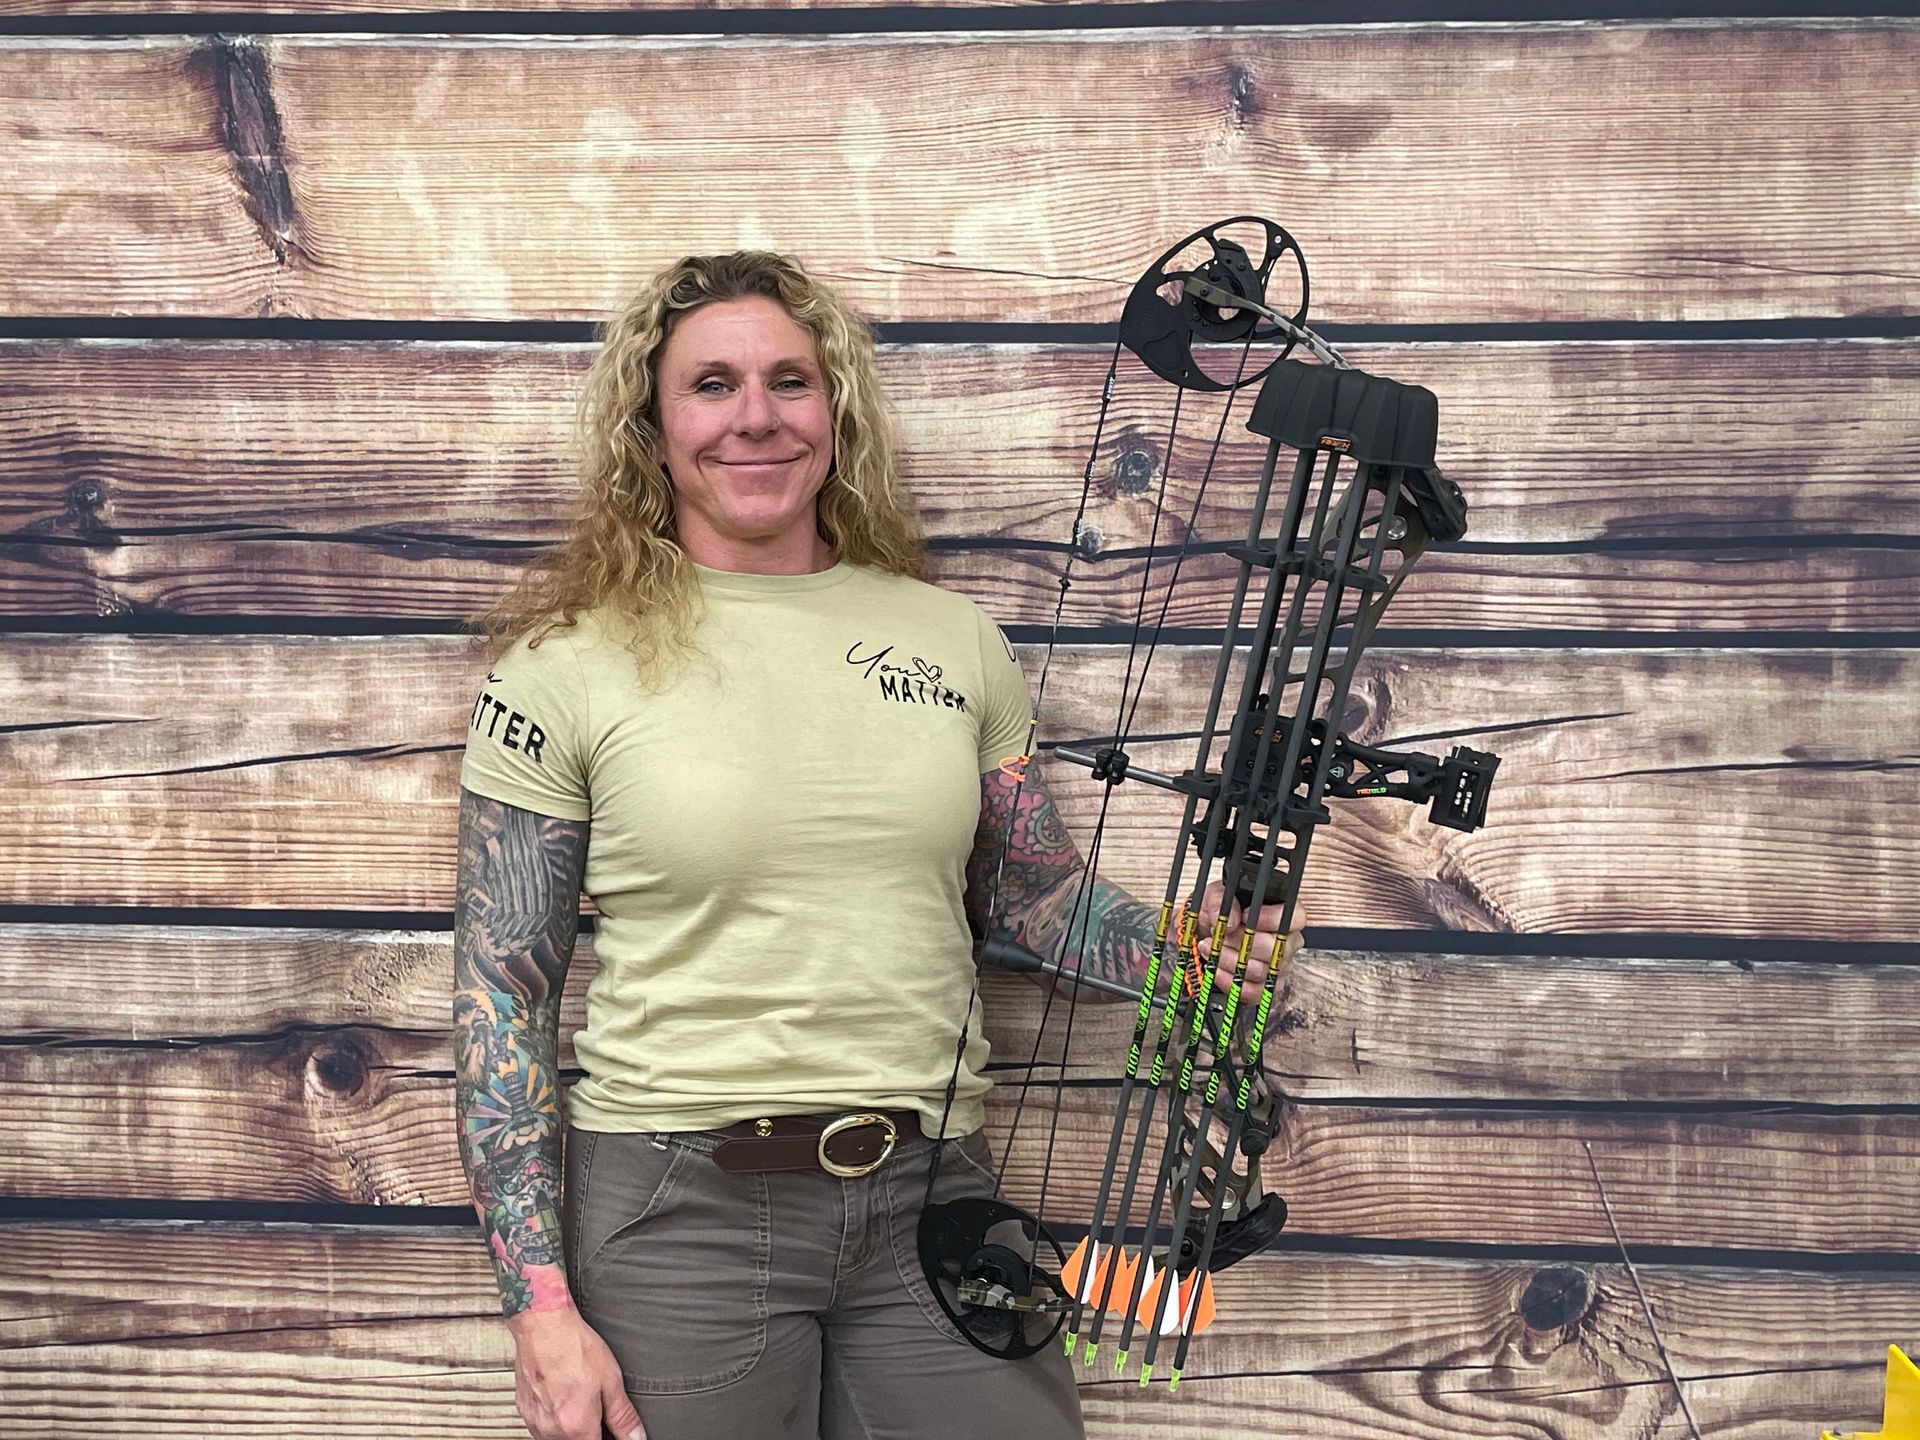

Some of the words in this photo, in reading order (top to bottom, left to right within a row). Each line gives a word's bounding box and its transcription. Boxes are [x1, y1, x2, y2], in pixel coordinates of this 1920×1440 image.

[846, 641, 921, 679] You
[1126, 1043, 1140, 1076] 400
[1150, 1054, 1164, 1086] 400
[1180, 1058, 1193, 1091] 400
[1205, 1071, 1219, 1104] 400
[1236, 1077, 1250, 1110] 400
